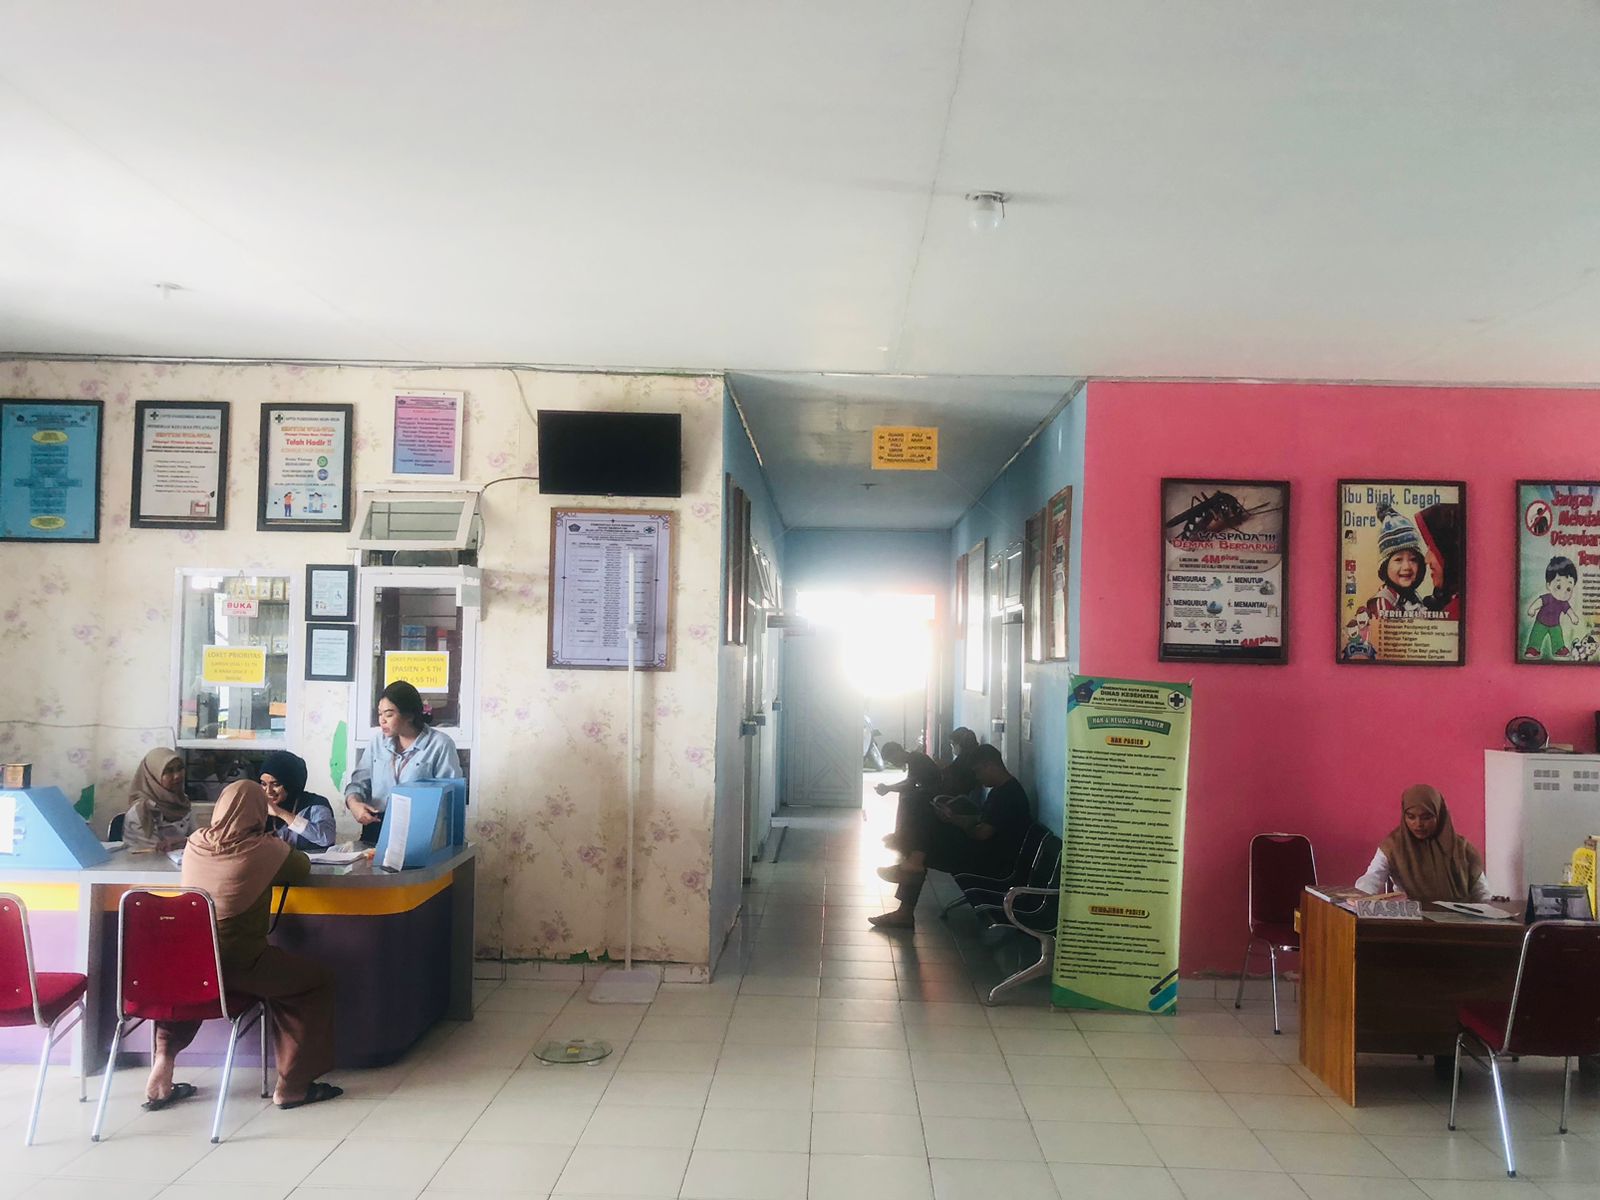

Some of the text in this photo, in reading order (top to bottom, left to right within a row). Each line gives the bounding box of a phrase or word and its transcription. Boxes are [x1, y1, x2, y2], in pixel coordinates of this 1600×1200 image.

[1344, 488, 1362, 503] Ibu
[1404, 488, 1440, 508] Cegah
[1552, 490, 1593, 510] Jangan
[1344, 510, 1376, 527] Diare
[1173, 538, 1277, 550] DEMAM BERDARAH
[1379, 610, 1420, 618] PERILAKU
[1166, 620, 1182, 629] plus
[1111, 717, 1142, 725] KEWAJIBAN
[1144, 720, 1164, 728] PASIEN
[1091, 906, 1145, 916] KEWAJIBAN PASIEN
[1358, 900, 1422, 917] KASIR
